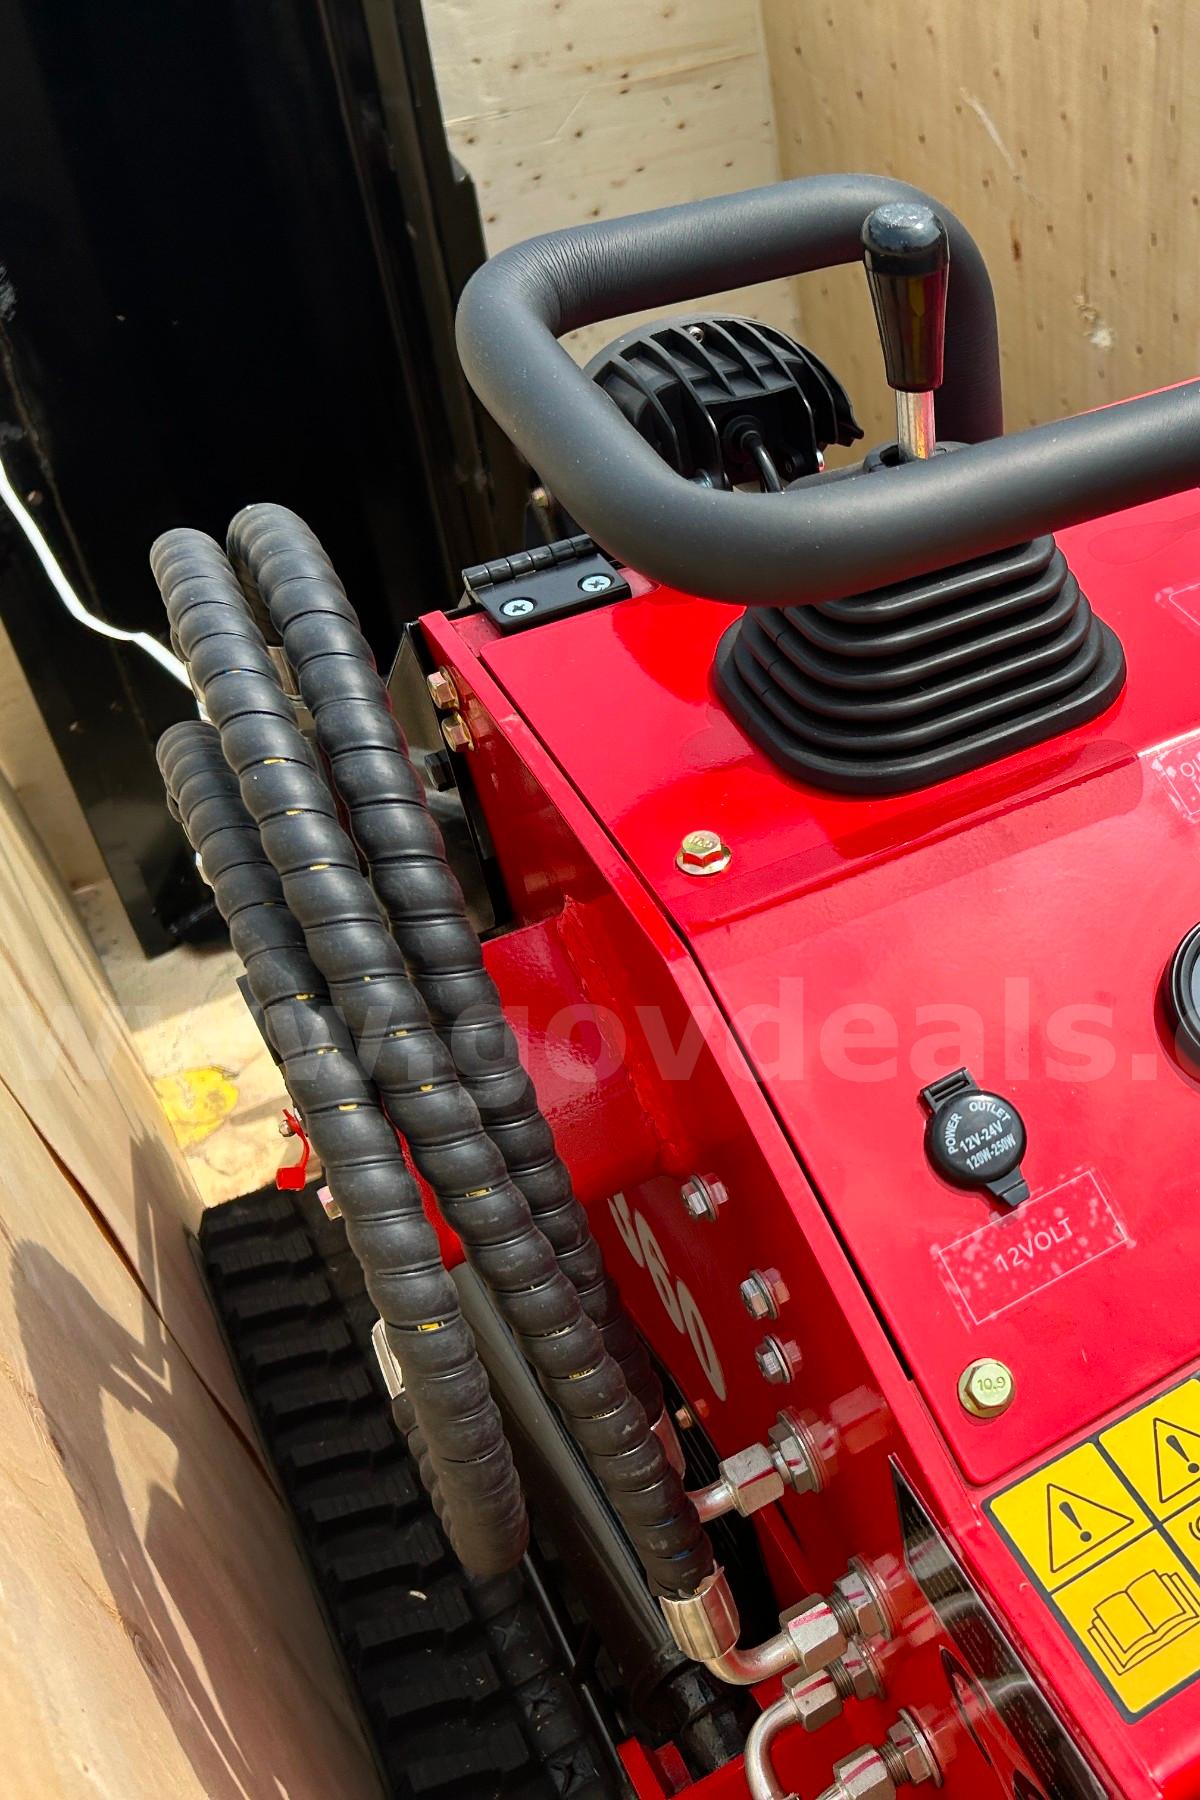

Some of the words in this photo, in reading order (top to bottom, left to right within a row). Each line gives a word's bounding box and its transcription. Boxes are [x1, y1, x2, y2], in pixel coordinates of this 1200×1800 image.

[946, 1112, 963, 1155] POWER
[968, 1100, 1012, 1123] OUTLET
[959, 1119, 1004, 1153] 12V-24V
[965, 1132, 1017, 1171] 120W-250W
[994, 1217, 1074, 1272] 12VOLT
[976, 1376, 1007, 1391] 10.9
